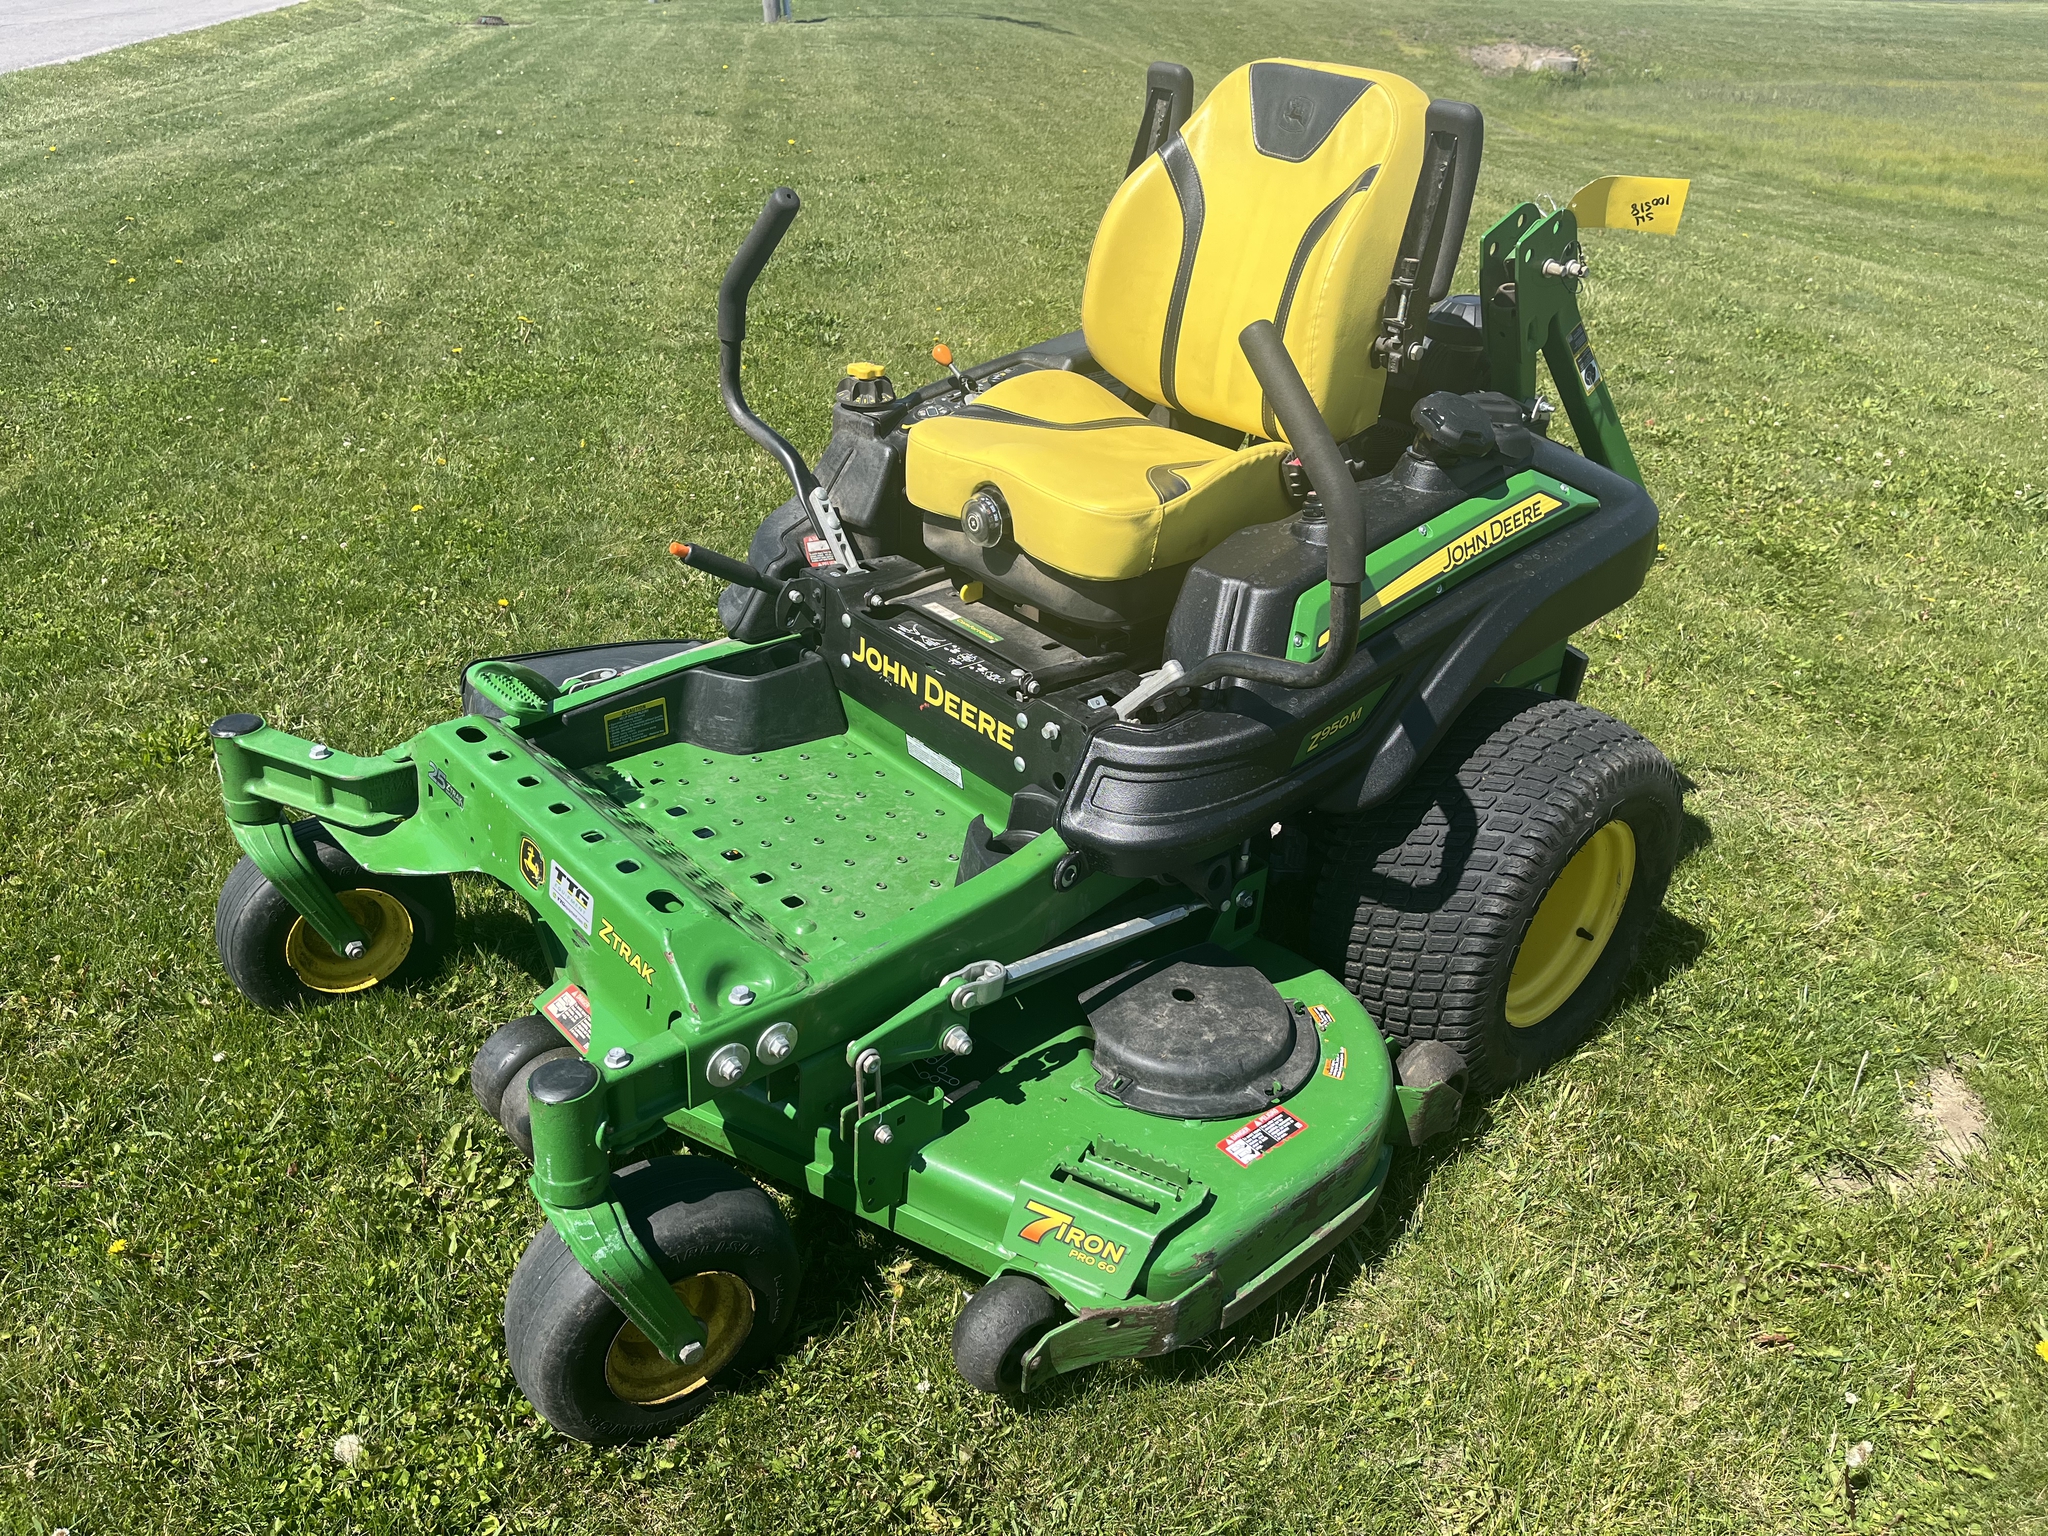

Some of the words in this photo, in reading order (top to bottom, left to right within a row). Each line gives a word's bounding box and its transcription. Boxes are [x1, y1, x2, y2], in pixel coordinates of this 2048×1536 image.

[1631, 194, 1670, 216] 815001
[1443, 530, 1488, 573] JOHN
[1490, 501, 1543, 543] DEERE
[852, 636, 918, 695] JOHN
[924, 672, 1016, 752] DEERE
[1306, 707, 1364, 753] Z950M
[428, 760, 446, 789] 25
[554, 866, 590, 909] TTG
[554, 883, 586, 915] EQUIPMENT
[598, 917, 657, 987] ZTRAK
[1017, 1199, 1075, 1244] 7
[1054, 1221, 1128, 1265] IRON
[1068, 1248, 1095, 1267] PRO
[1096, 1258, 1117, 1274] 60
